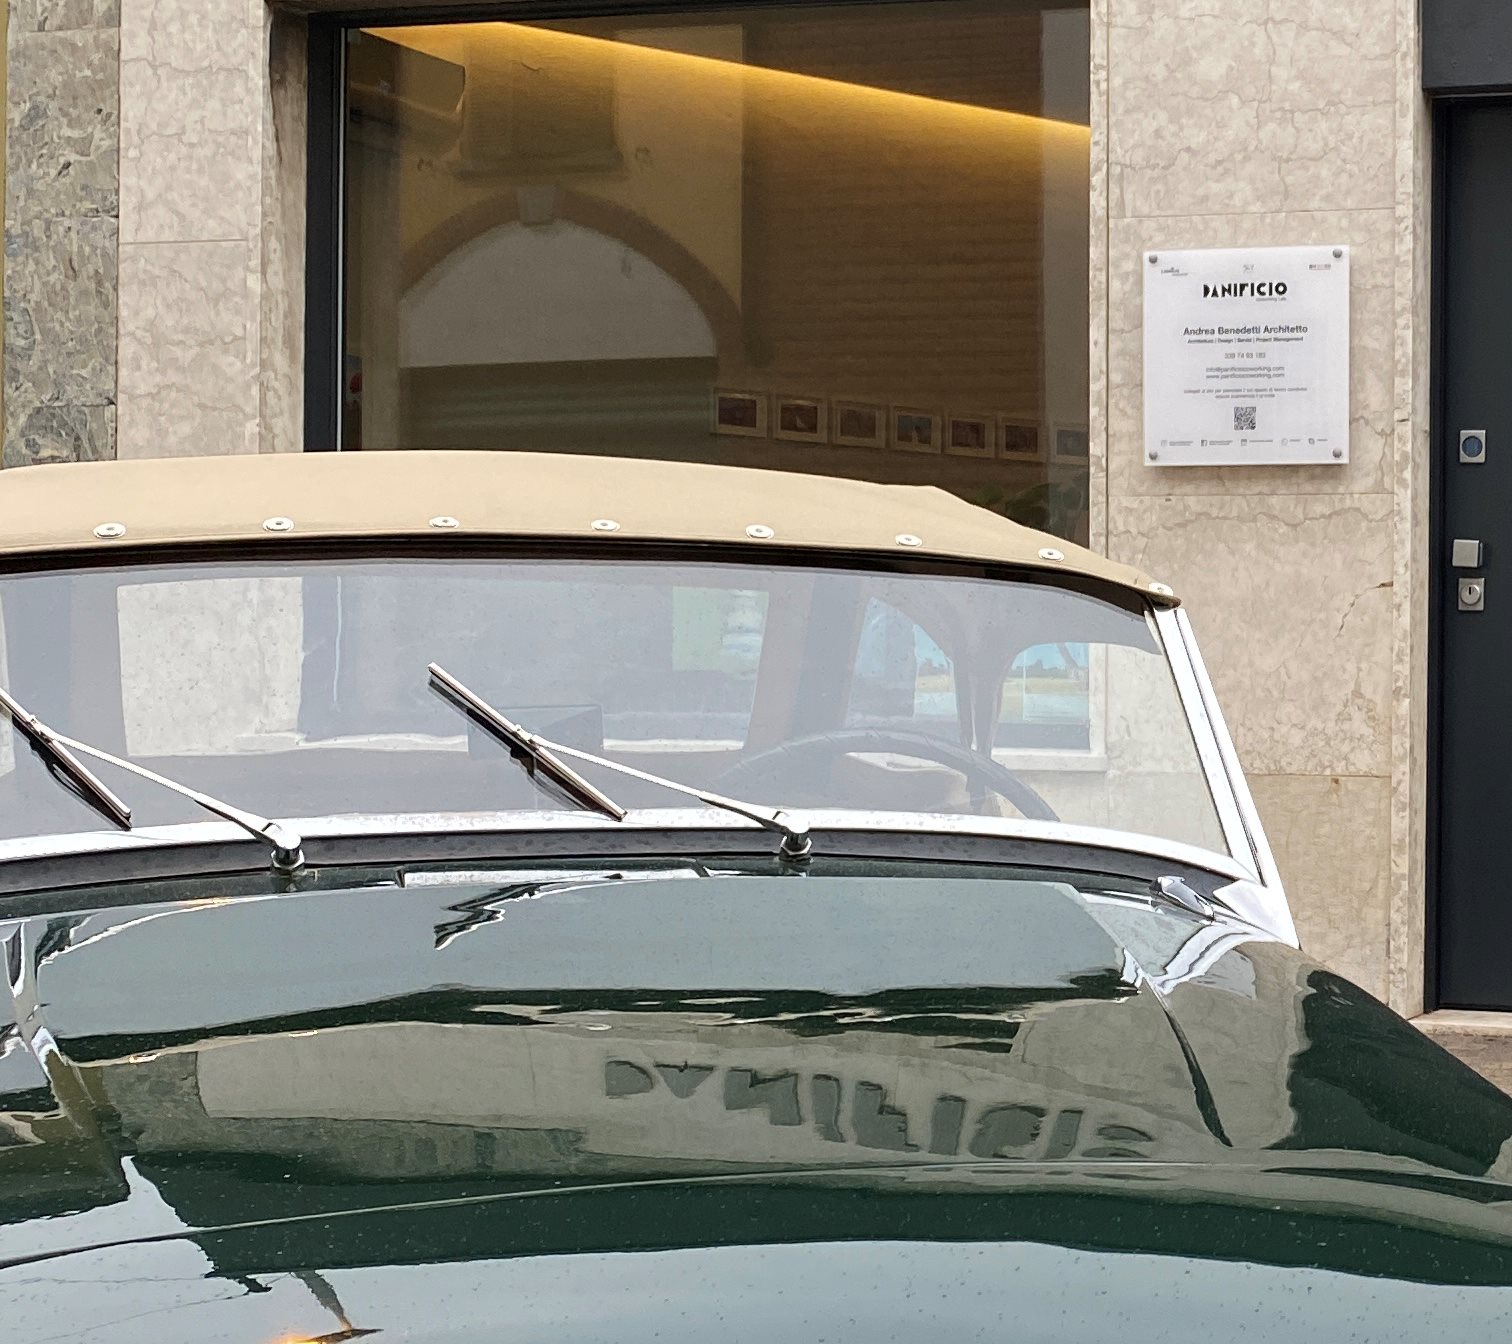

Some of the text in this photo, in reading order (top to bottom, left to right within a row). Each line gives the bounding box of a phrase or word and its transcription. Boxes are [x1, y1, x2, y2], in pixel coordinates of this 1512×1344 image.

[1203, 281, 1288, 298] PANIFICIO
[1183, 325, 1308, 336] Andrea Benedetti Architetto
